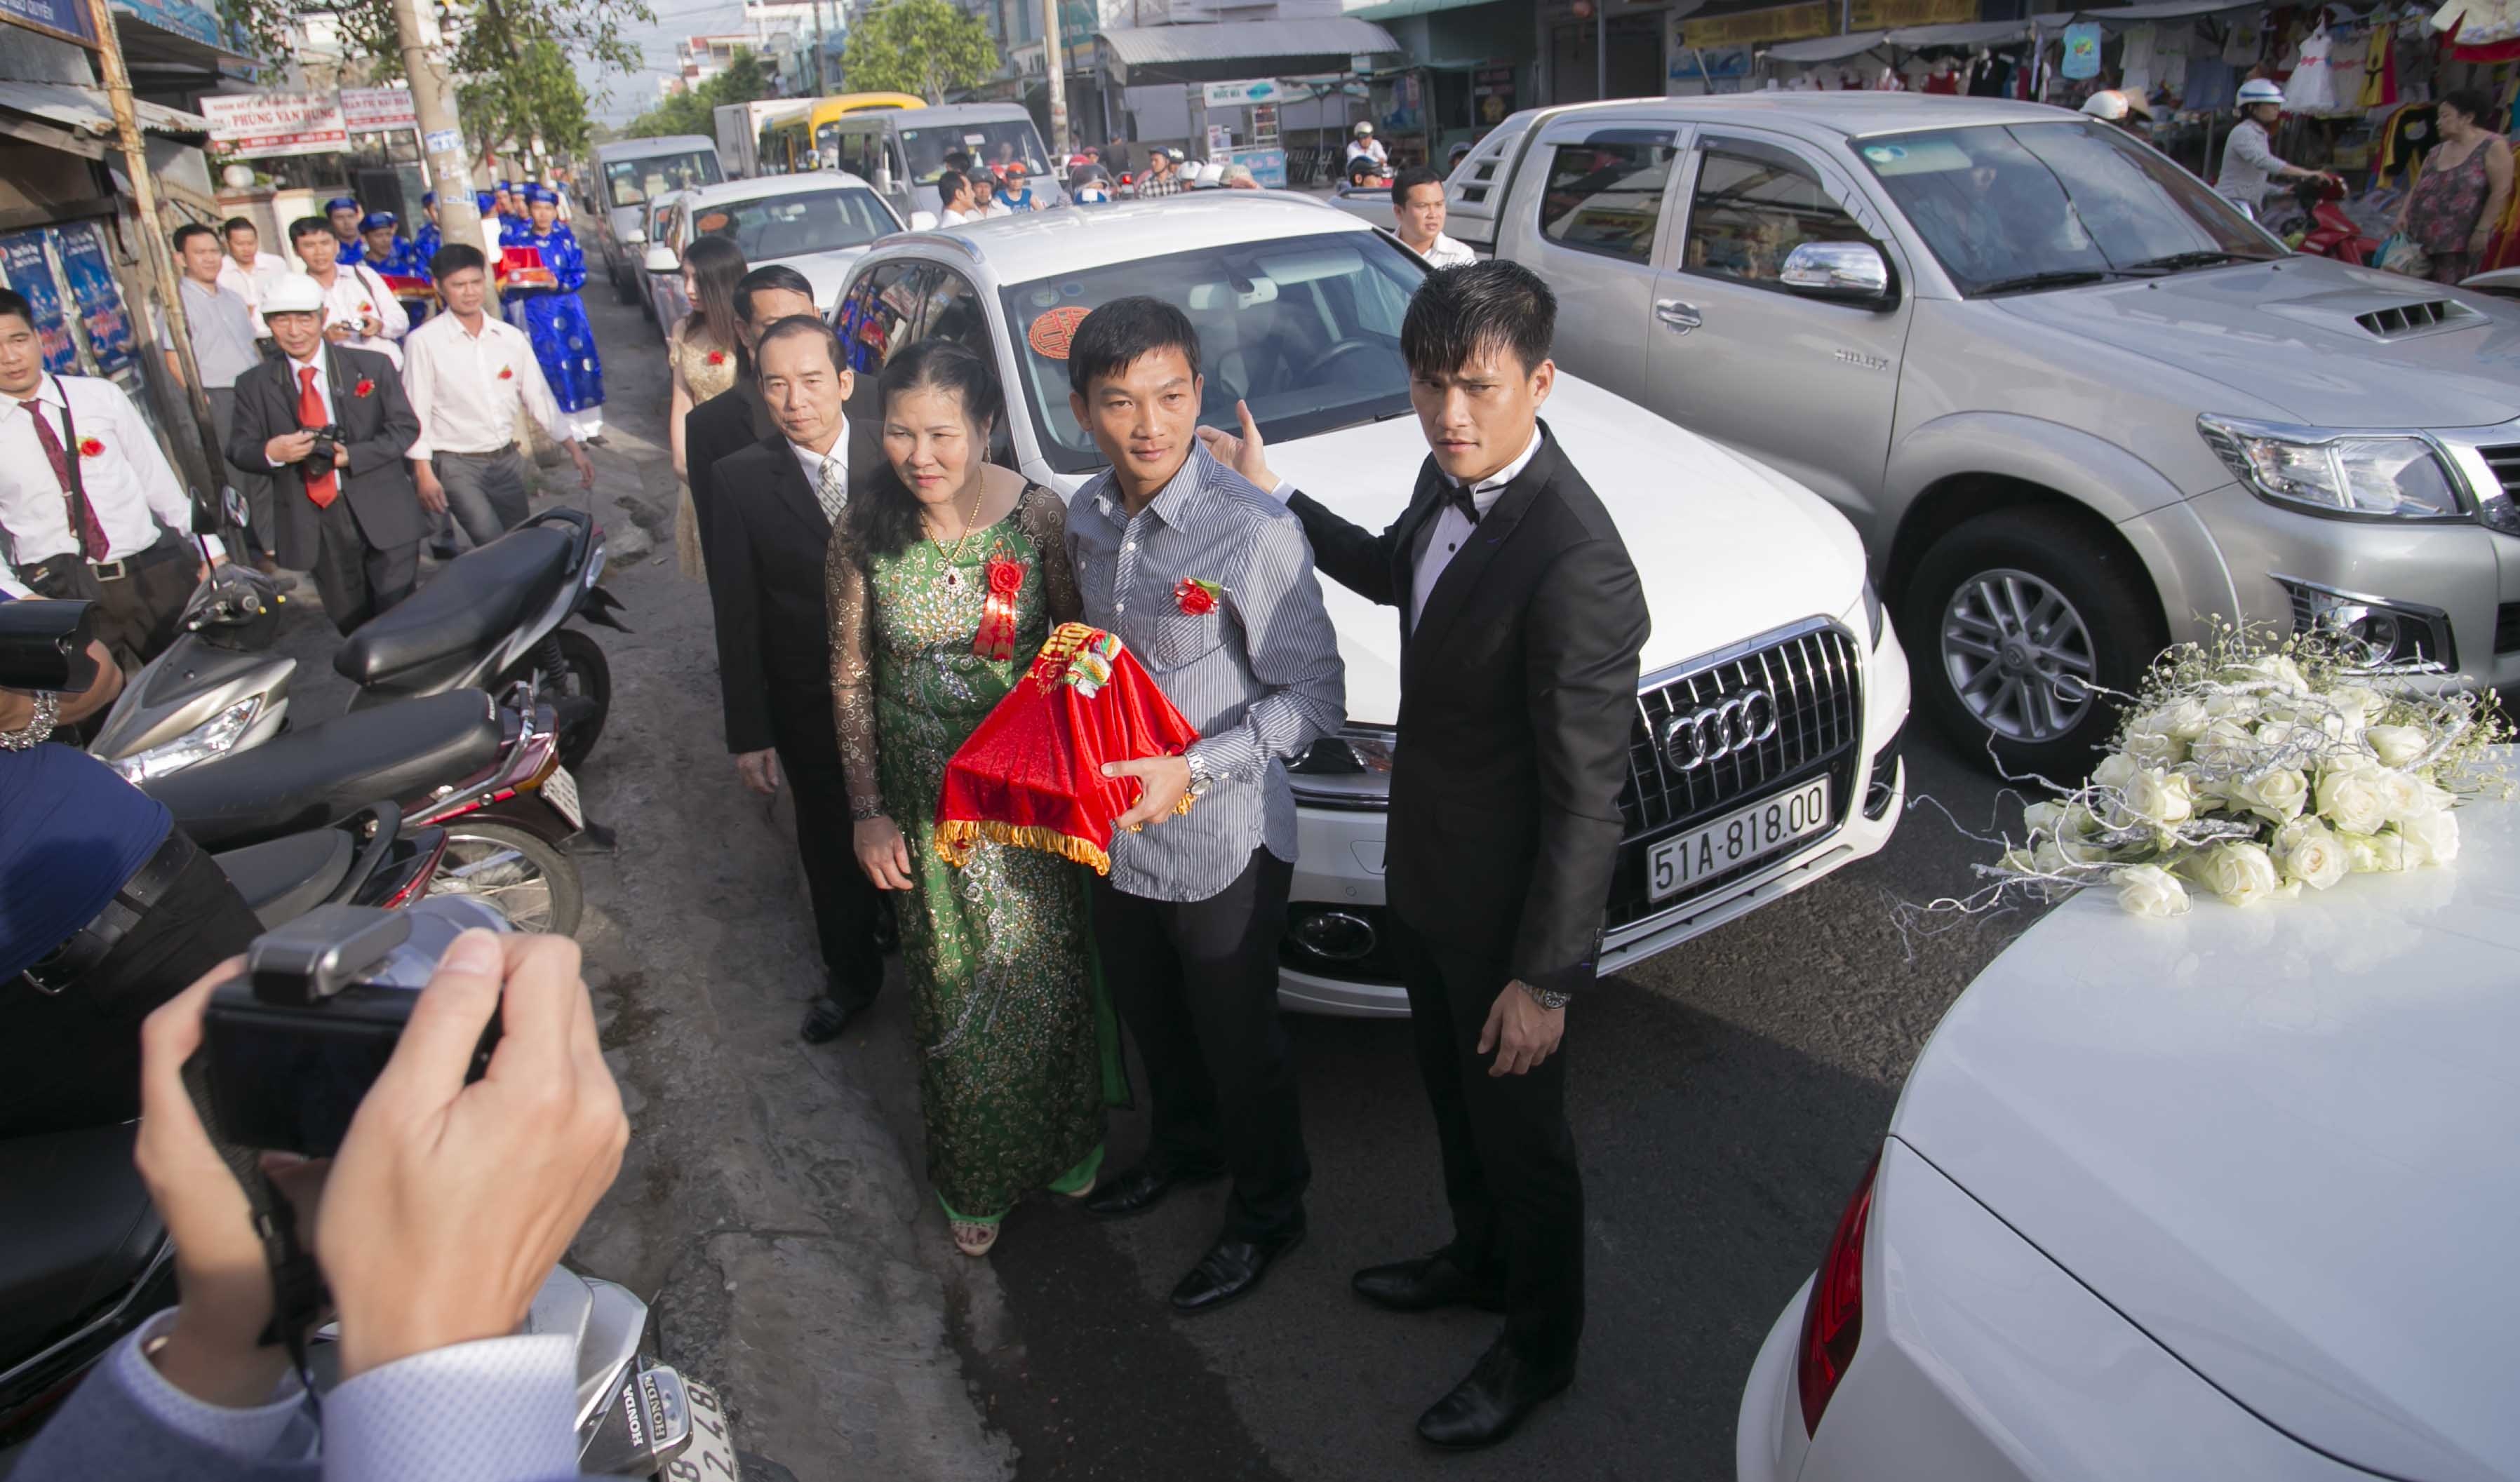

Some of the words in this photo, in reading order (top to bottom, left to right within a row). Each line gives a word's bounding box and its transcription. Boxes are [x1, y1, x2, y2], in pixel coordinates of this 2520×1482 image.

[1655, 786, 1822, 889] 51A-818.00
[623, 1383, 643, 1447] HONDA
[643, 1374, 666, 1439] HONDA
